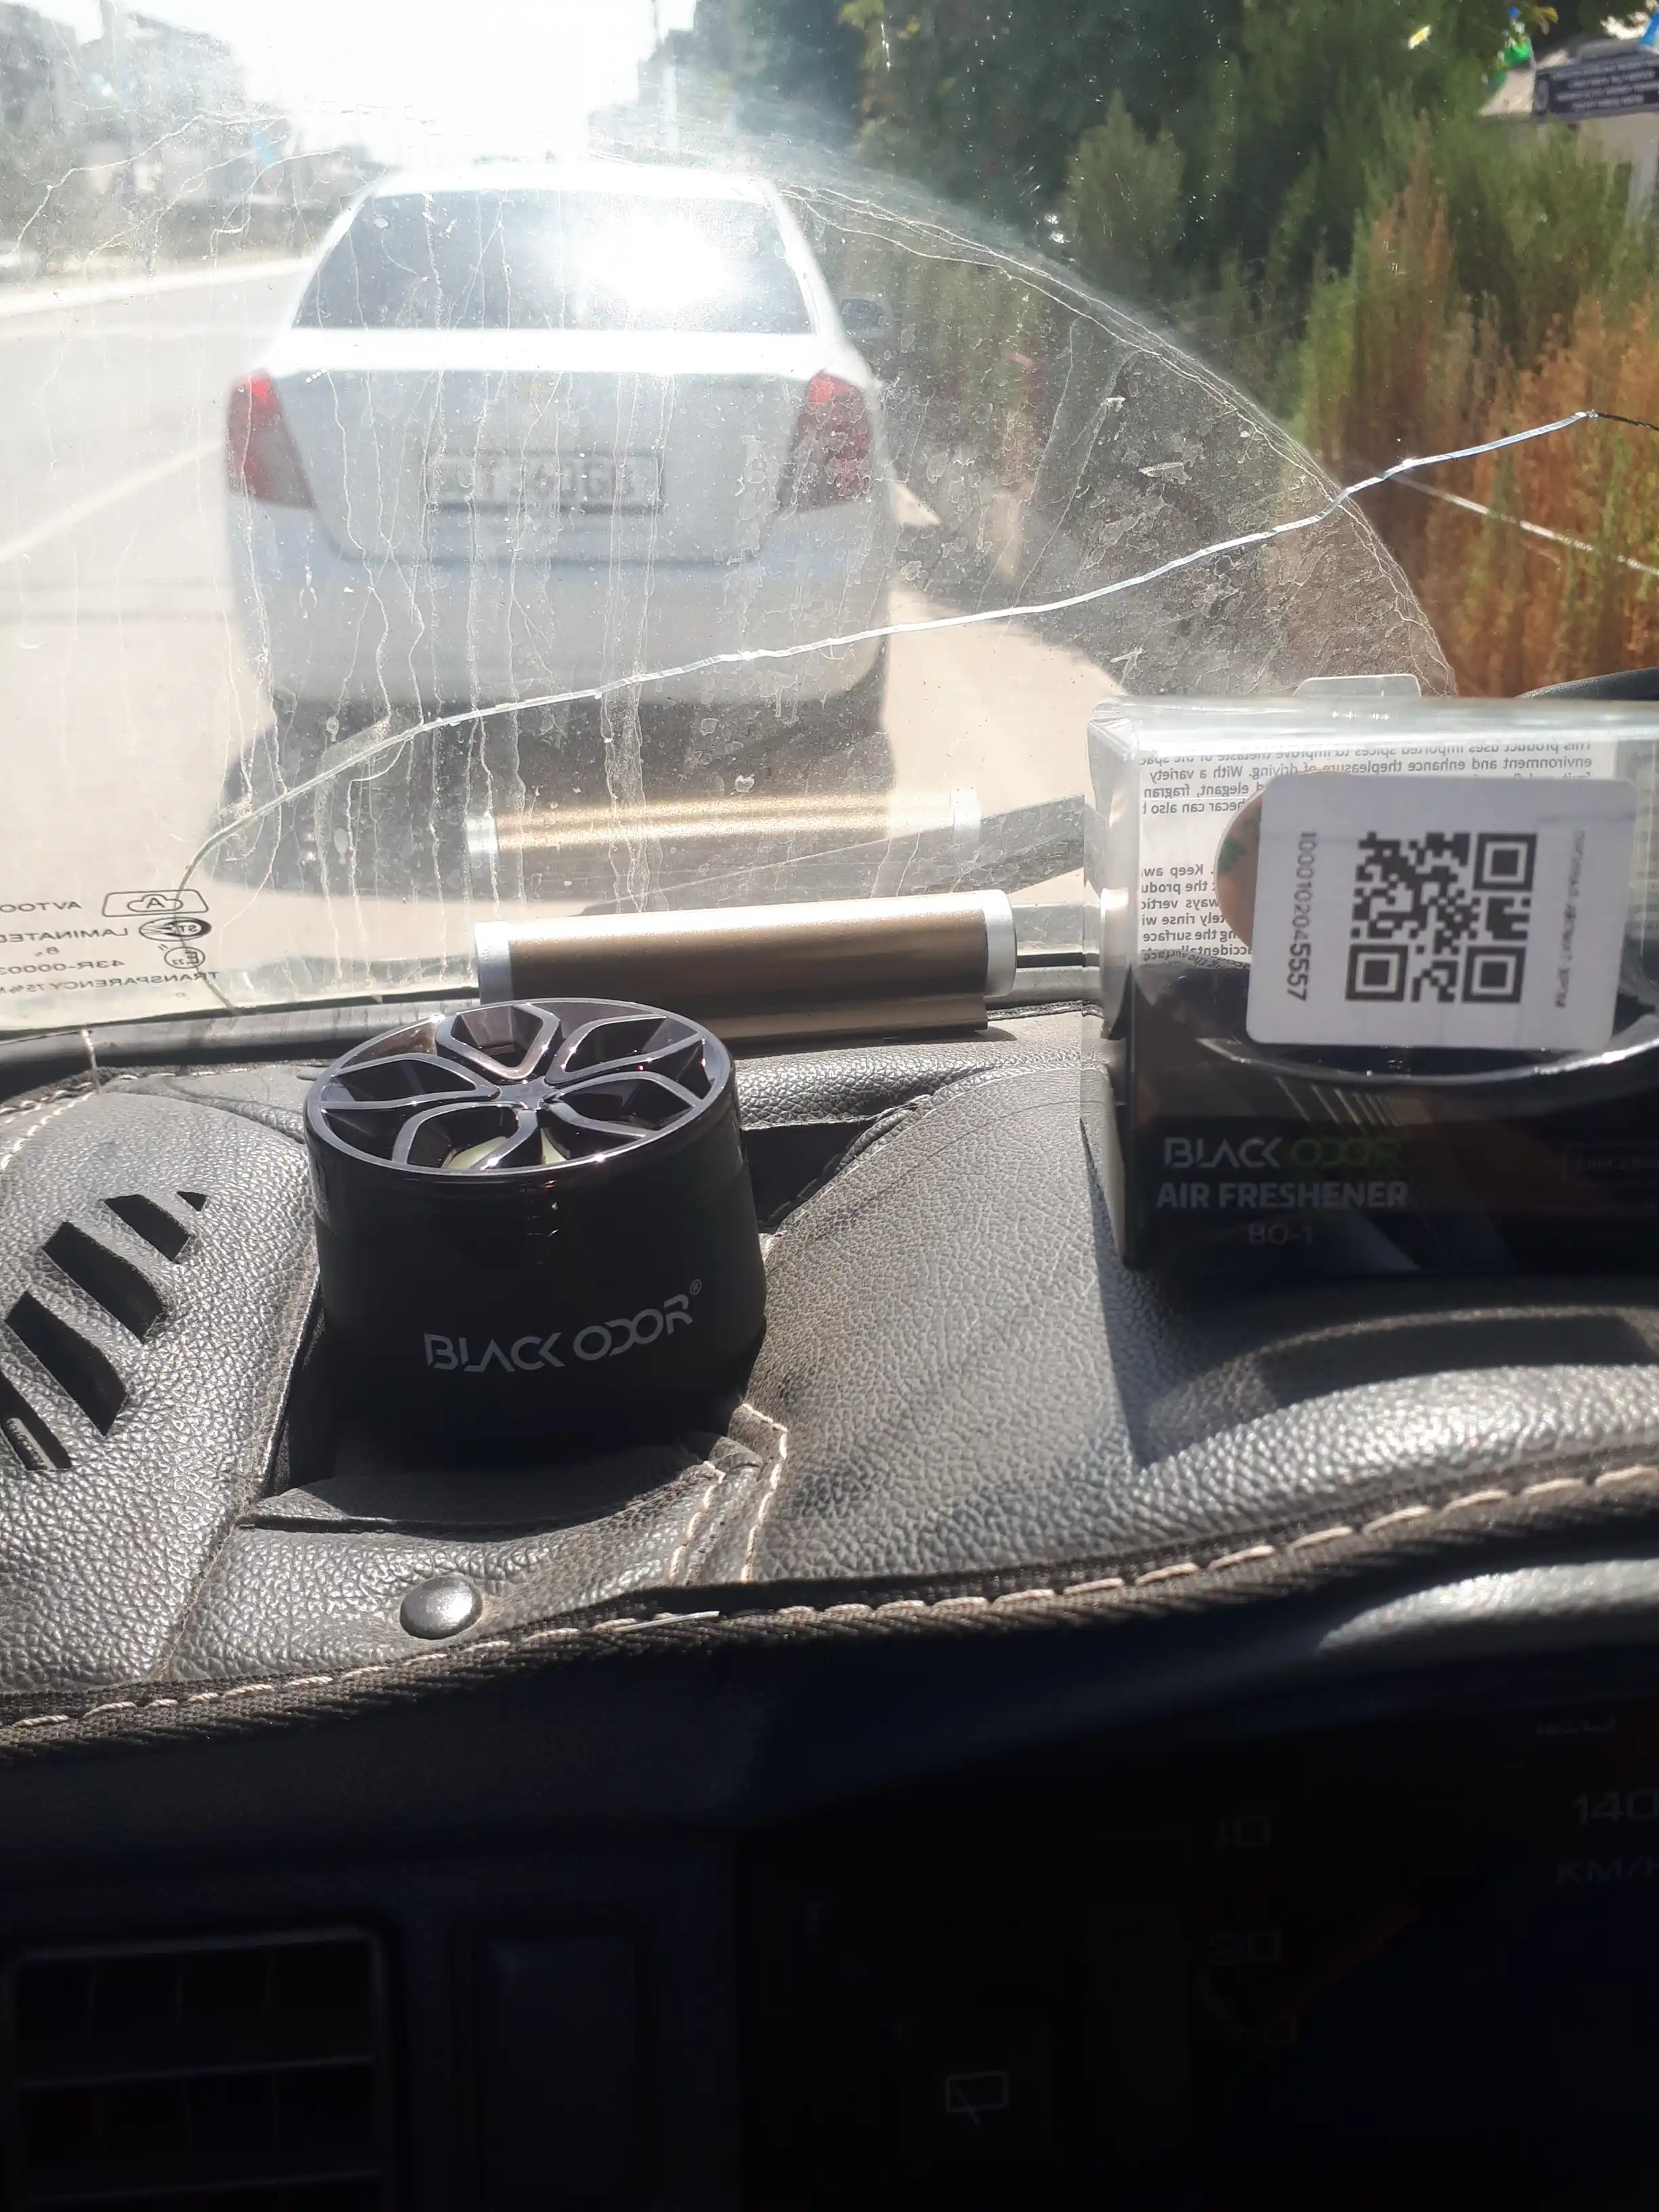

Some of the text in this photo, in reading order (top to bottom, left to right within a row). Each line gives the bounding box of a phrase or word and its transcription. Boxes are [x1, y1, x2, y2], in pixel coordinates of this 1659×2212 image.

[1163, 1136, 1403, 1170] BLACK ODOR
[1155, 1181, 1409, 1210] AIR FRESHENER
[1248, 1223, 1313, 1246] BO-1
[423, 1332, 566, 1373] BLACK
